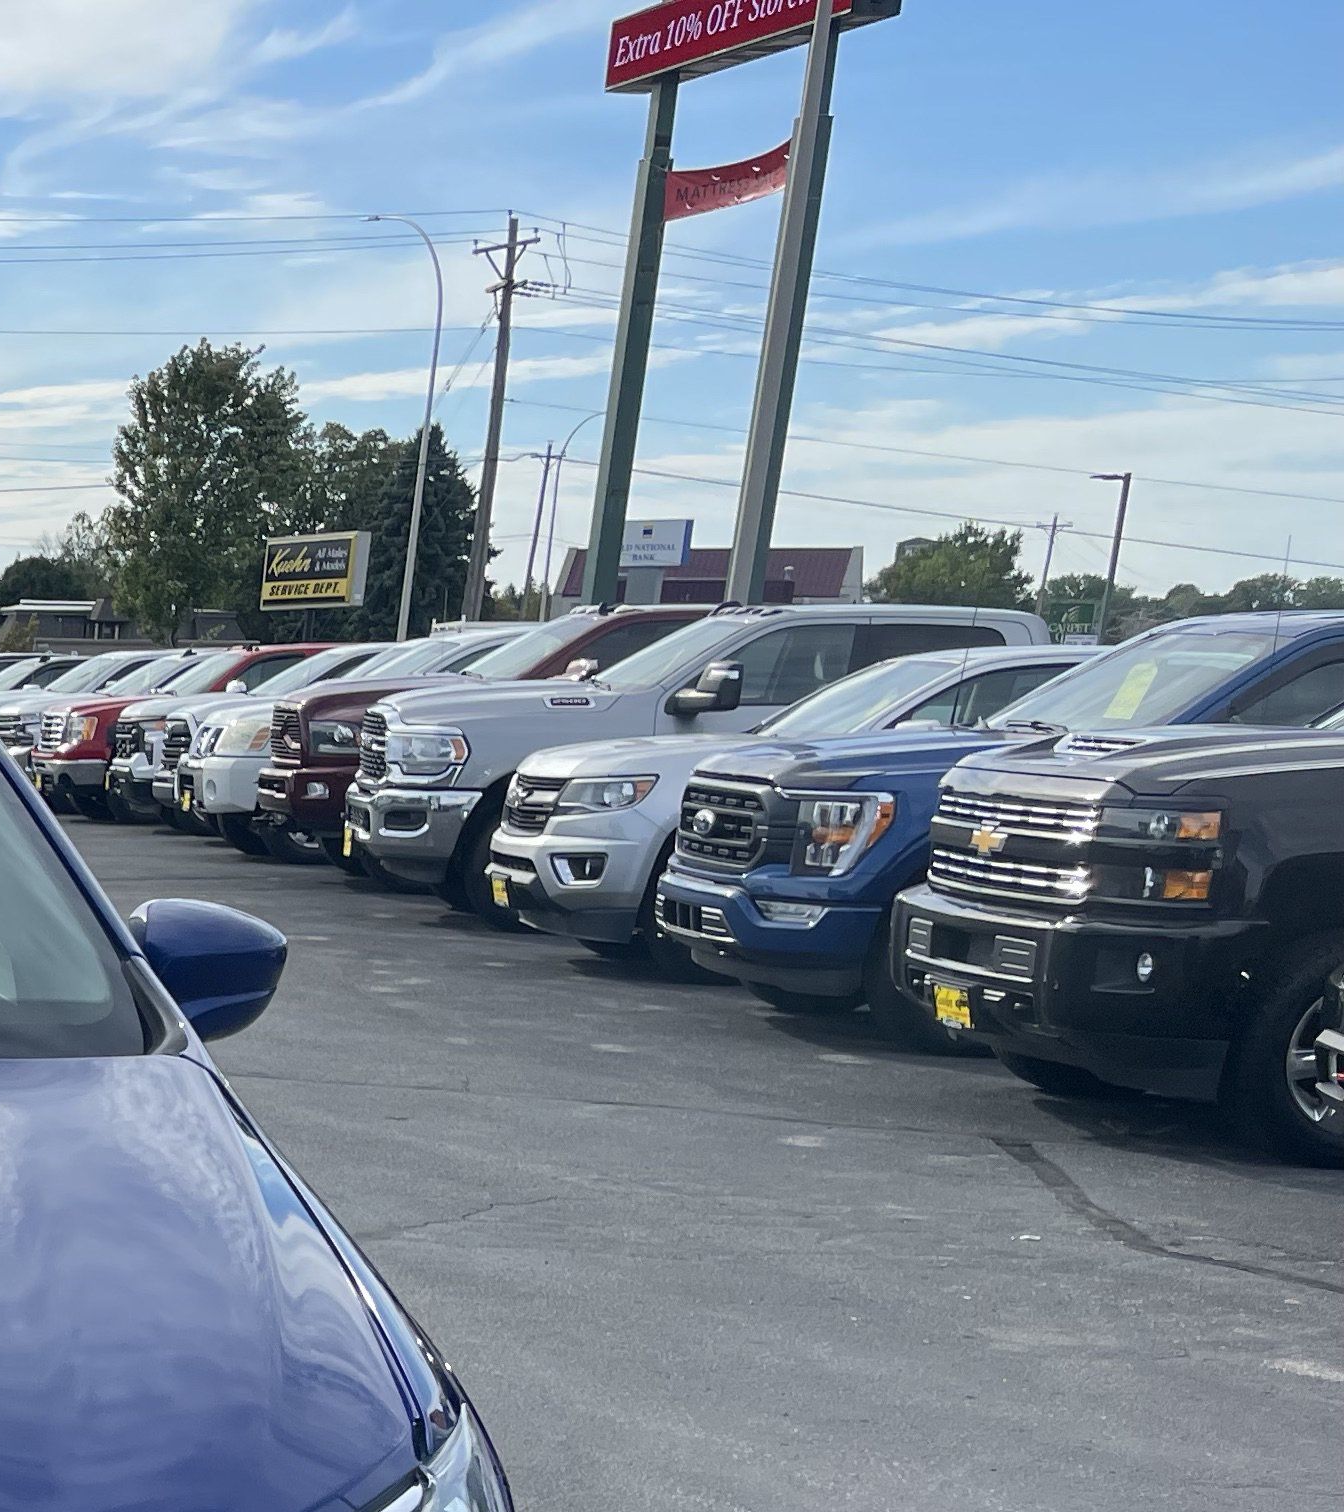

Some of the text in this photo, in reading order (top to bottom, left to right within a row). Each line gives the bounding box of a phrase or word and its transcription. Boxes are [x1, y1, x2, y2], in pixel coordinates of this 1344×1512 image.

[614, 33, 660, 66] Extra
[664, 11, 703, 50] 10%
[708, 0, 743, 35] OFF
[634, 543, 676, 552] NATIONAL
[268, 546, 311, 577] Kuehn
[632, 553, 655, 561] BANK
[269, 582, 339, 596] SERVICE DEPT.
